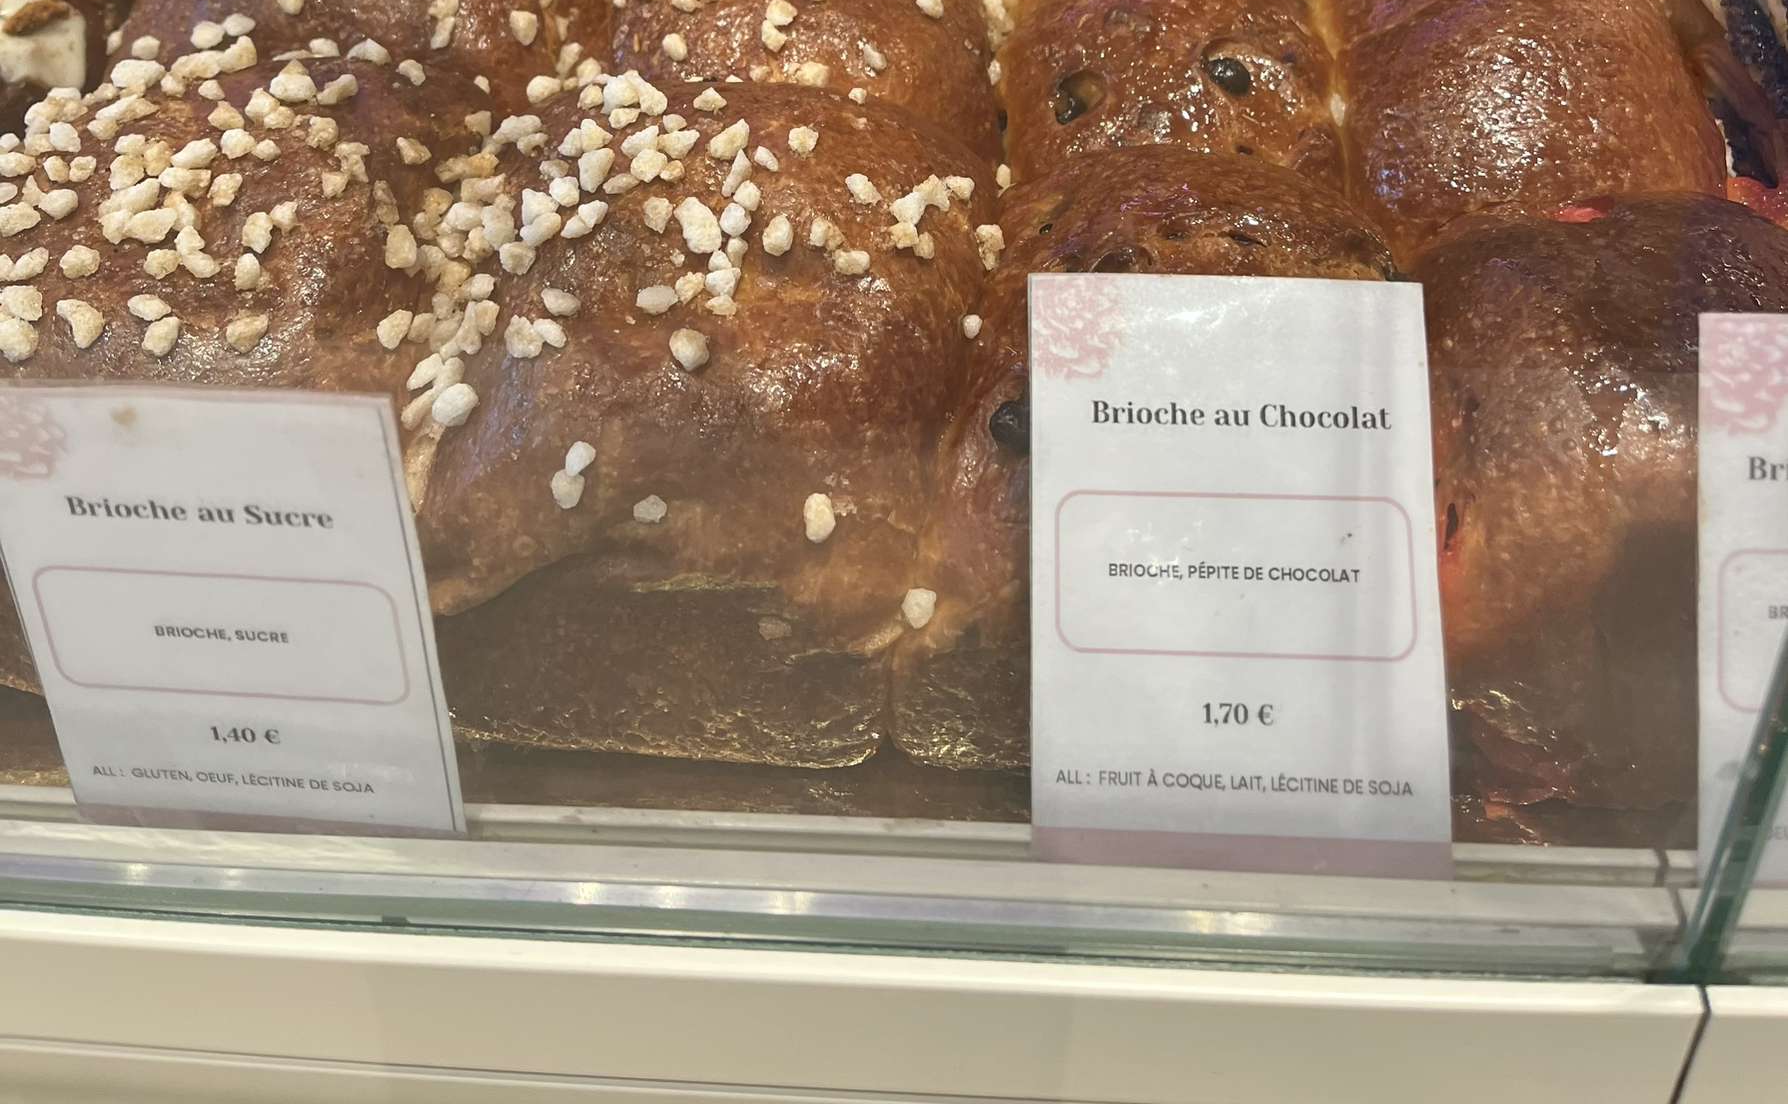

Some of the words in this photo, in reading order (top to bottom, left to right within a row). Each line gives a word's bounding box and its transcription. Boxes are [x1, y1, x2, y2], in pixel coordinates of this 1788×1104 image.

[1092, 400, 1206, 426] Brioche
[1214, 409, 1250, 427] au
[1259, 403, 1393, 430] Chocolat
[64, 496, 188, 521] Brioche
[198, 505, 236, 524] au
[243, 504, 334, 529] Sucre
[1109, 563, 1184, 581] BRIOCHE,
[1188, 561, 1239, 580] PÉPITE
[1244, 566, 1264, 581] DE
[1268, 567, 1361, 583] CHOCOLAT
[154, 625, 232, 641] BRIOCHE,
[235, 630, 289, 644] SUCRE
[1202, 702, 1249, 726] 1,70
[1257, 703, 1275, 726] €
[210, 726, 257, 744] 1,40
[264, 729, 282, 745] €
[131, 767, 193, 783] GLUTEN,
[196, 771, 240, 786] OEUF,
[242, 773, 305, 790] LÉCITINE
[309, 779, 329, 792] DE
[332, 782, 376, 794] SOJA
[1098, 770, 1142, 786] FRUIT
[1147, 768, 1159, 787] À
[1163, 773, 1227, 790] COQUE,
[1231, 775, 1266, 791] LAIT,
[1271, 773, 1339, 794] LÉCITINE
[1343, 779, 1364, 794] DE
[1368, 780, 1414, 796] SOJA
